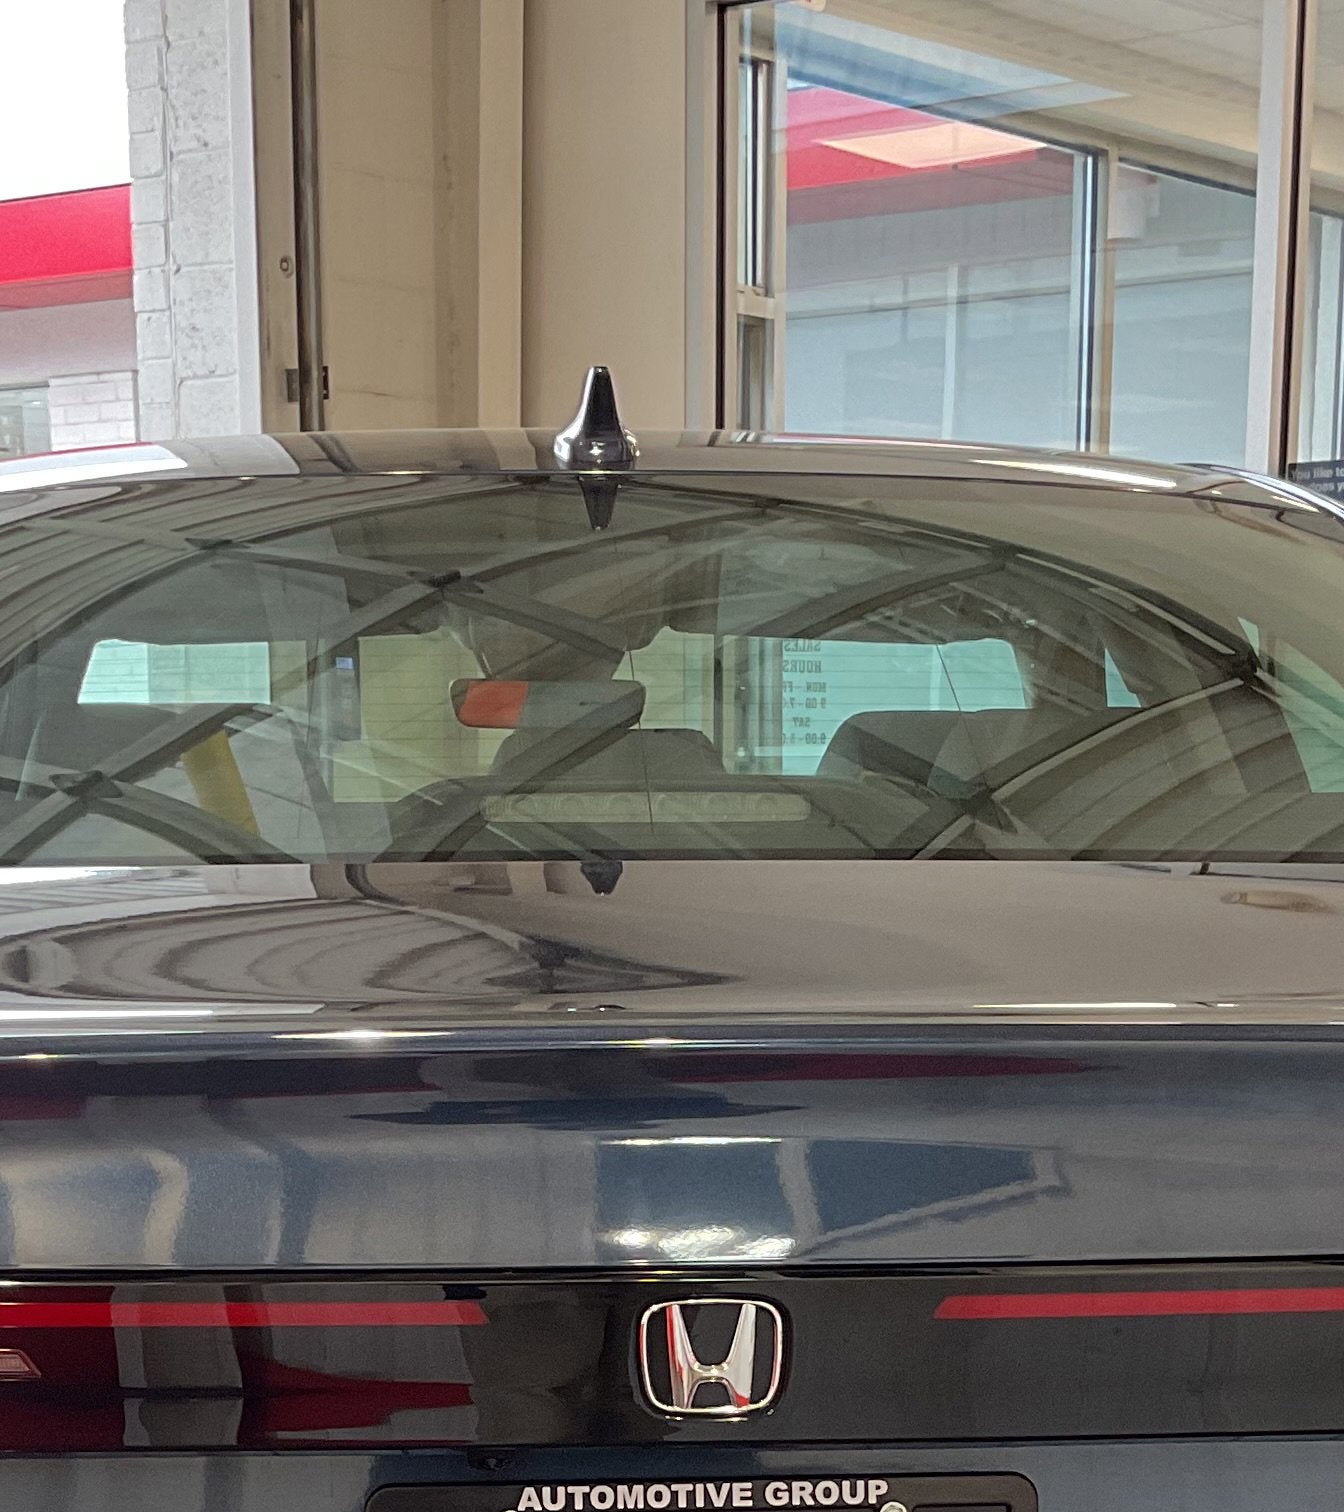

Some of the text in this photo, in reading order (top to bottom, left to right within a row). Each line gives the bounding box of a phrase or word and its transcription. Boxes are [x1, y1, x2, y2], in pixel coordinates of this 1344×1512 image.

[1313, 467, 1333, 479] like
[517, 1479, 889, 1512] AUTOMOTIVE GROUP
